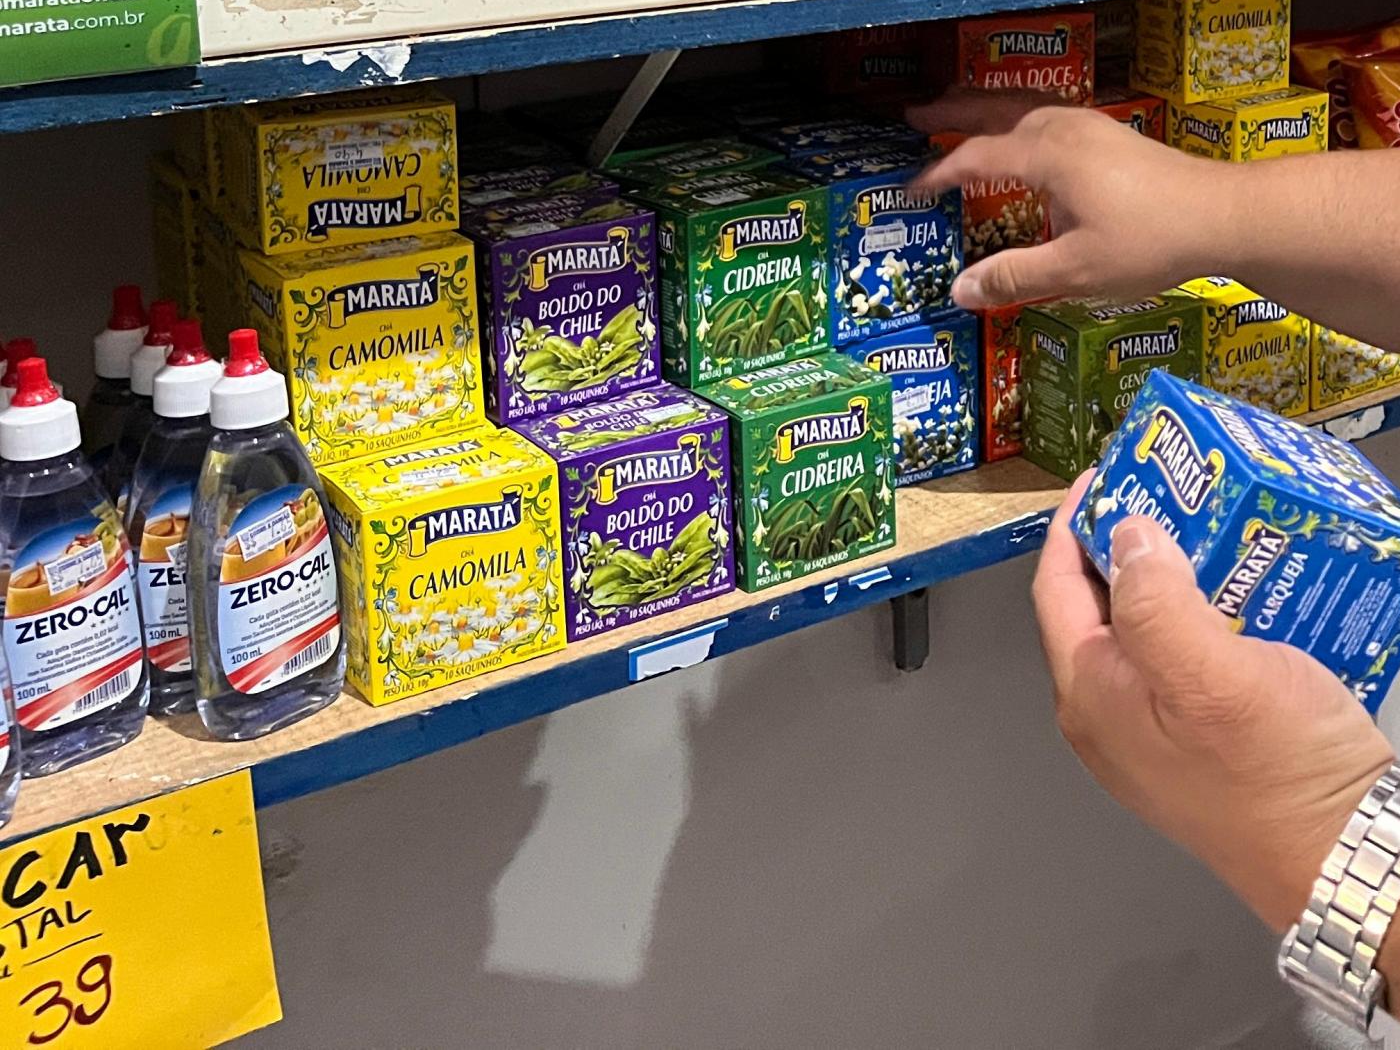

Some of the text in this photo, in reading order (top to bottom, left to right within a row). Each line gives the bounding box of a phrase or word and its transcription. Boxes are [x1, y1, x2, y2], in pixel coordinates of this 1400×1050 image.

[1208, 9, 1273, 35] CAMOMILA
[1002, 28, 1067, 55] MARATÁ
[1027, 65, 1072, 88] DOCE
[1266, 115, 1311, 140] MARATÁ
[736, 212, 802, 245] MARATÁ
[547, 241, 623, 274] MARATÁ
[723, 254, 803, 295] CIDREIRA
[347, 276, 436, 312] MARATÁ
[538, 284, 622, 321] BOLDO DO
[559, 310, 603, 339] CHILE
[328, 324, 445, 371] CAMOMILA
[882, 342, 948, 373] MARATÁ
[1120, 329, 1178, 360] MARATÁ
[1225, 333, 1291, 369] CAMOMILA
[559, 395, 568, 406] 10
[568, 384, 609, 405] SAQUINHOS
[750, 368, 840, 399] CIDREIRA
[585, 412, 632, 431] BOLDO
[793, 409, 863, 446] MARATÁ
[366, 440, 375, 451] 10
[375, 429, 423, 450] SAQUINHOS
[817, 449, 830, 461] CHÁ
[616, 447, 696, 486] MARATÁ
[780, 452, 866, 497] CIDREIRA
[1154, 420, 1213, 507] MARATÁ
[643, 490, 657, 502] CHÁ
[429, 498, 520, 541] MARATÁ
[606, 492, 694, 535] BOLDO DO
[629, 521, 675, 551] CHILE
[460, 547, 475, 559] CHÁ
[811, 550, 849, 571] SAQUINHOS
[409, 546, 527, 600] CAMOMILA
[1217, 529, 1284, 616] MARATÁ
[1255, 551, 1310, 631] CARQUEJA
[575, 622, 591, 636] PESO
[629, 607, 638, 619] 10
[638, 594, 682, 617] SAQUINHOS
[150, 628, 182, 640] 100 mL
[231, 647, 264, 665] 100 mL
[17, 683, 52, 701] 100 mL
[383, 685, 401, 699] PESO
[445, 670, 454, 682] 10
[454, 655, 504, 680] SAQUINHOS
[0, 900, 93, 957] TAL
